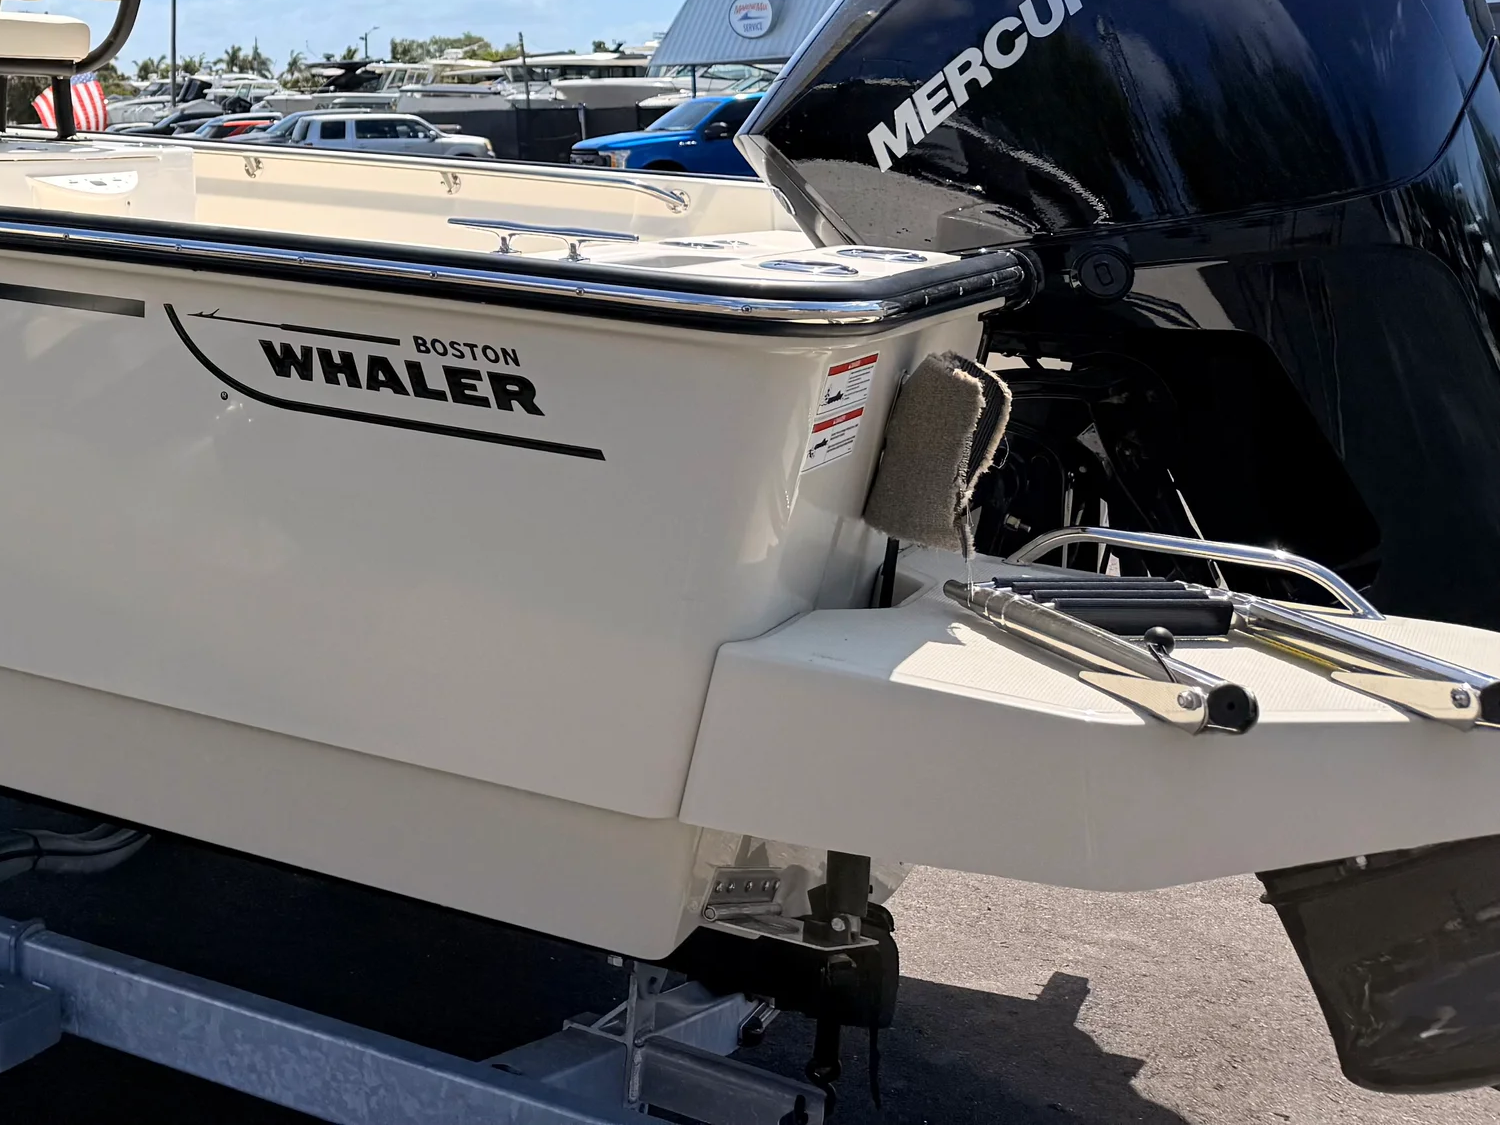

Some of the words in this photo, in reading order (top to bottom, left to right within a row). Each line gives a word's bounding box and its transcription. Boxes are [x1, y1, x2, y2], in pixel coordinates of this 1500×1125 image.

[742, 22, 763, 33] SERVICE
[412, 335, 521, 367] BOSTON
[258, 339, 546, 416] WHALER
